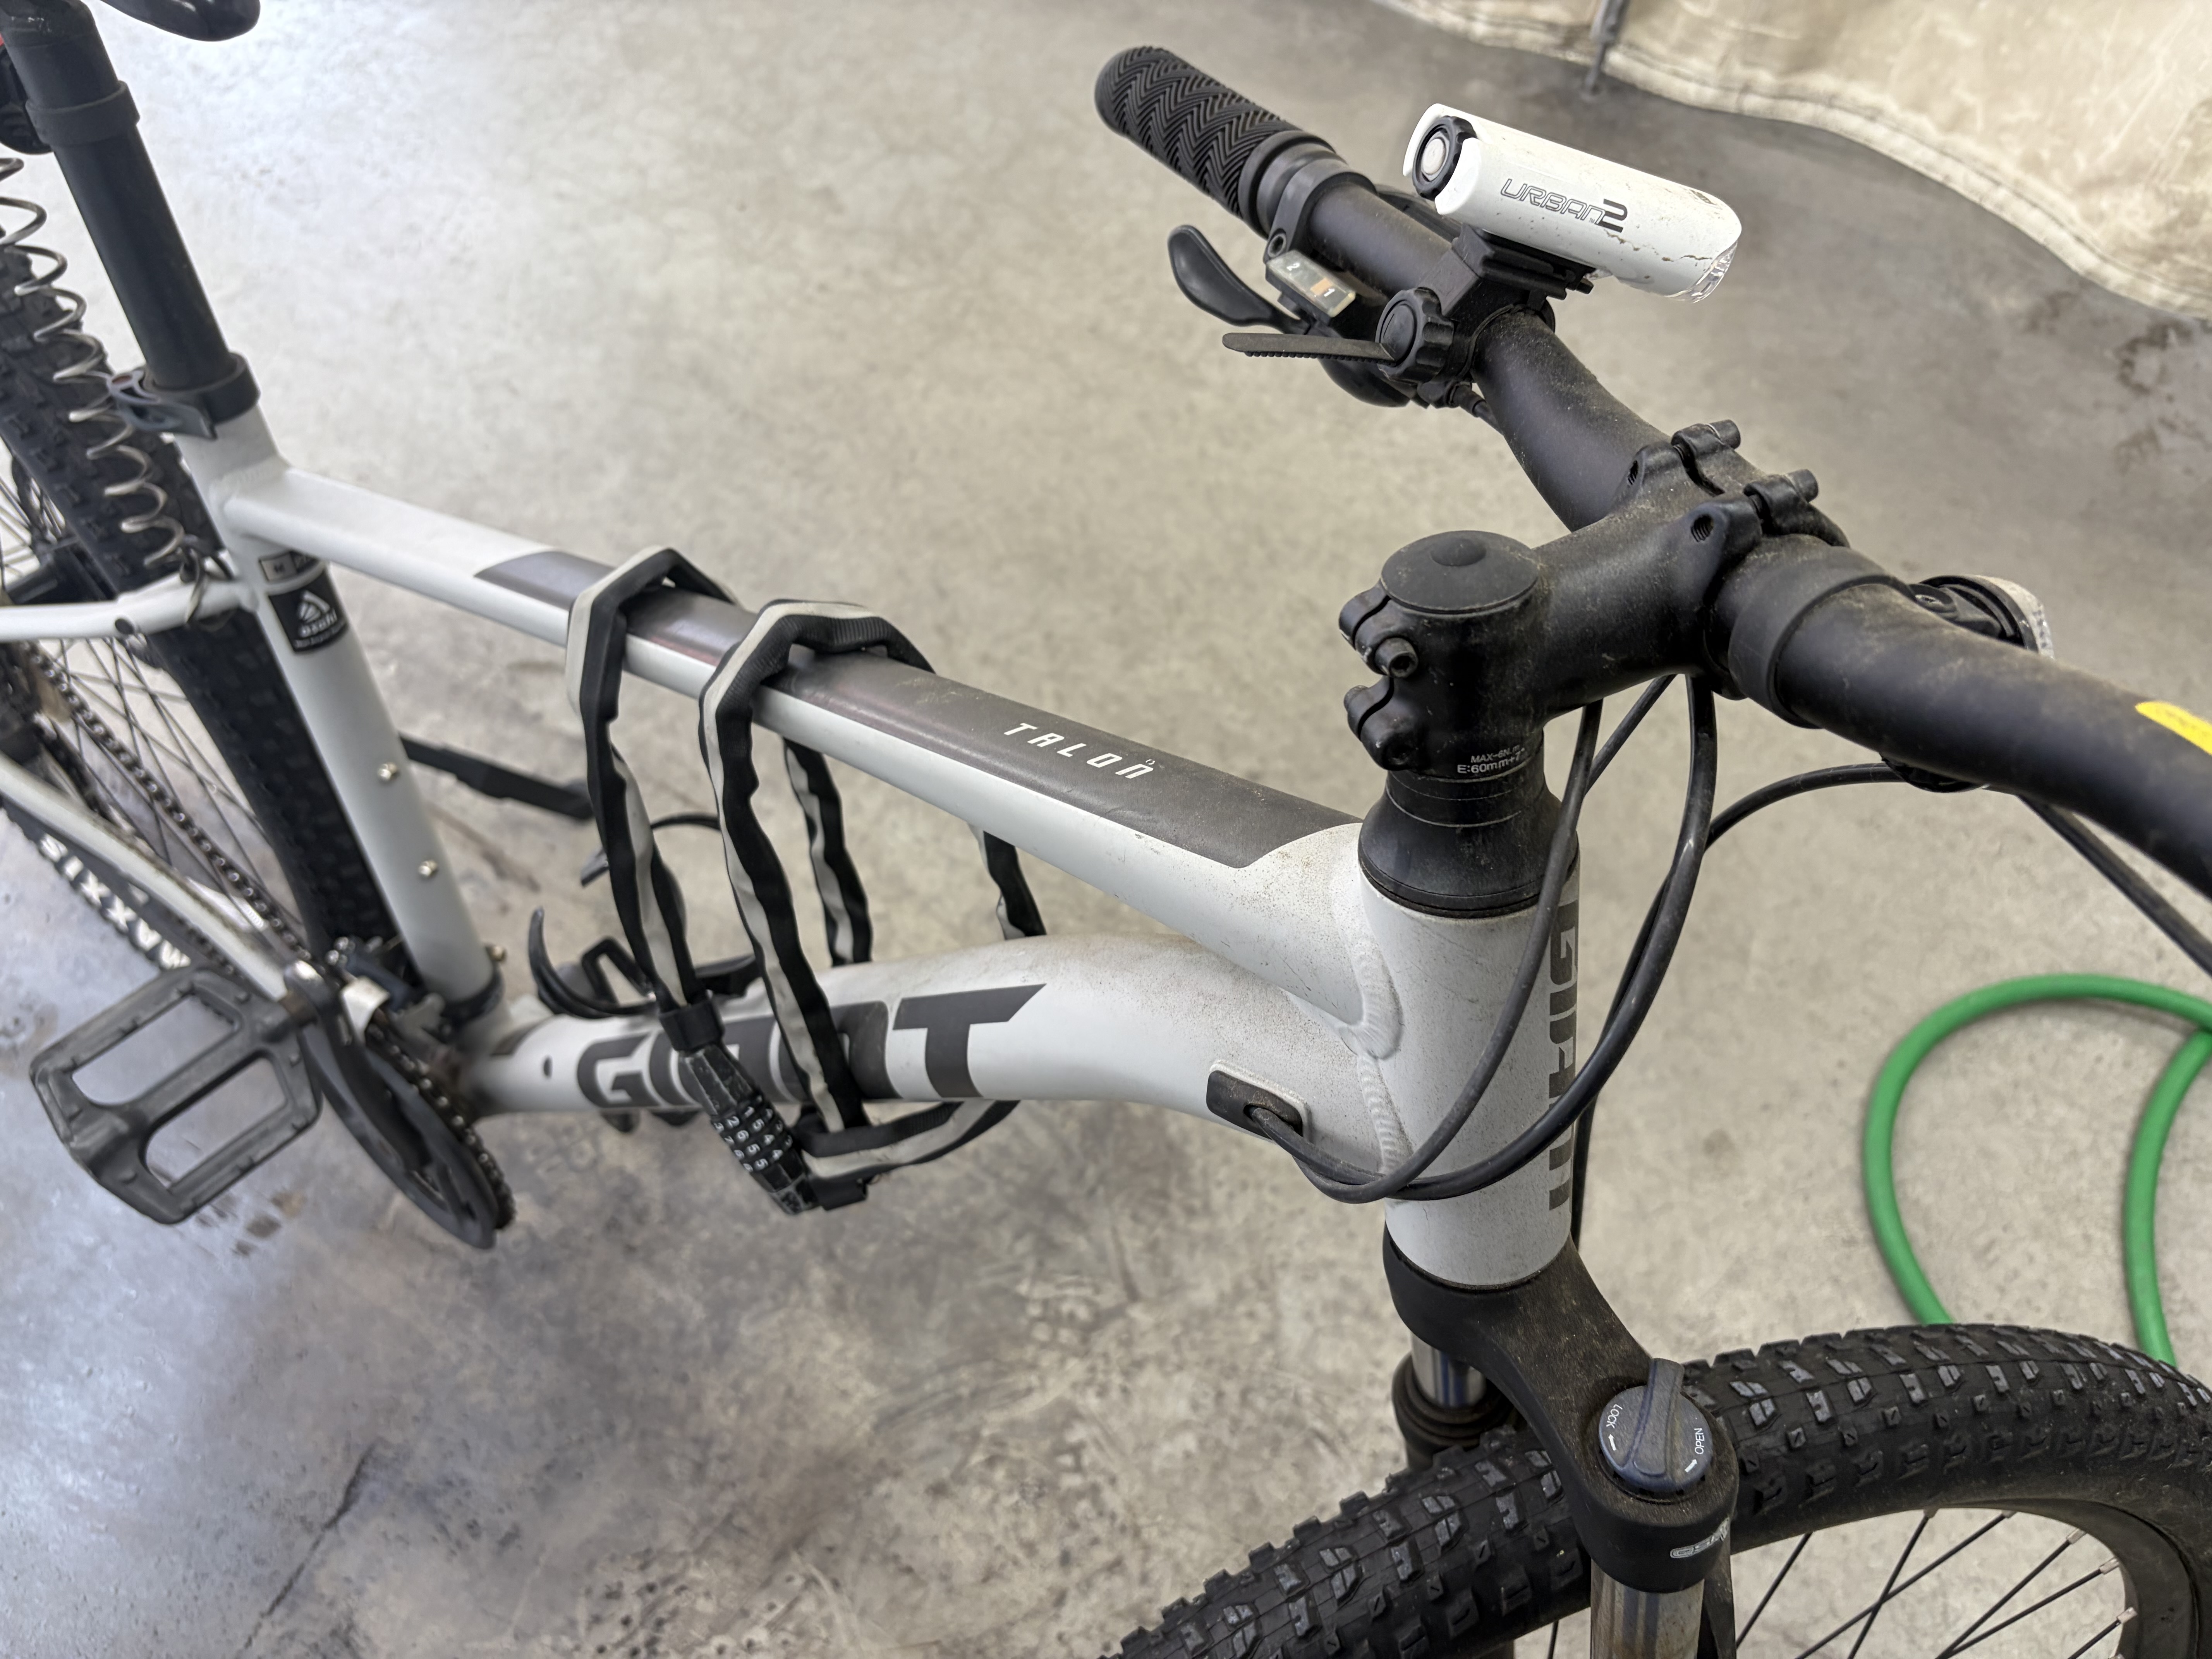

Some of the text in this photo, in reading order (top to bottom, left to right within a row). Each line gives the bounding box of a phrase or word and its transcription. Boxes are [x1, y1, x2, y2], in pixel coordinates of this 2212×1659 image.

[1286, 262, 1300, 271] 2
[1323, 288, 1335, 297] 1
[1606, 1403, 1623, 1429] LOCK
[1694, 1428, 1705, 1455] OPEN
